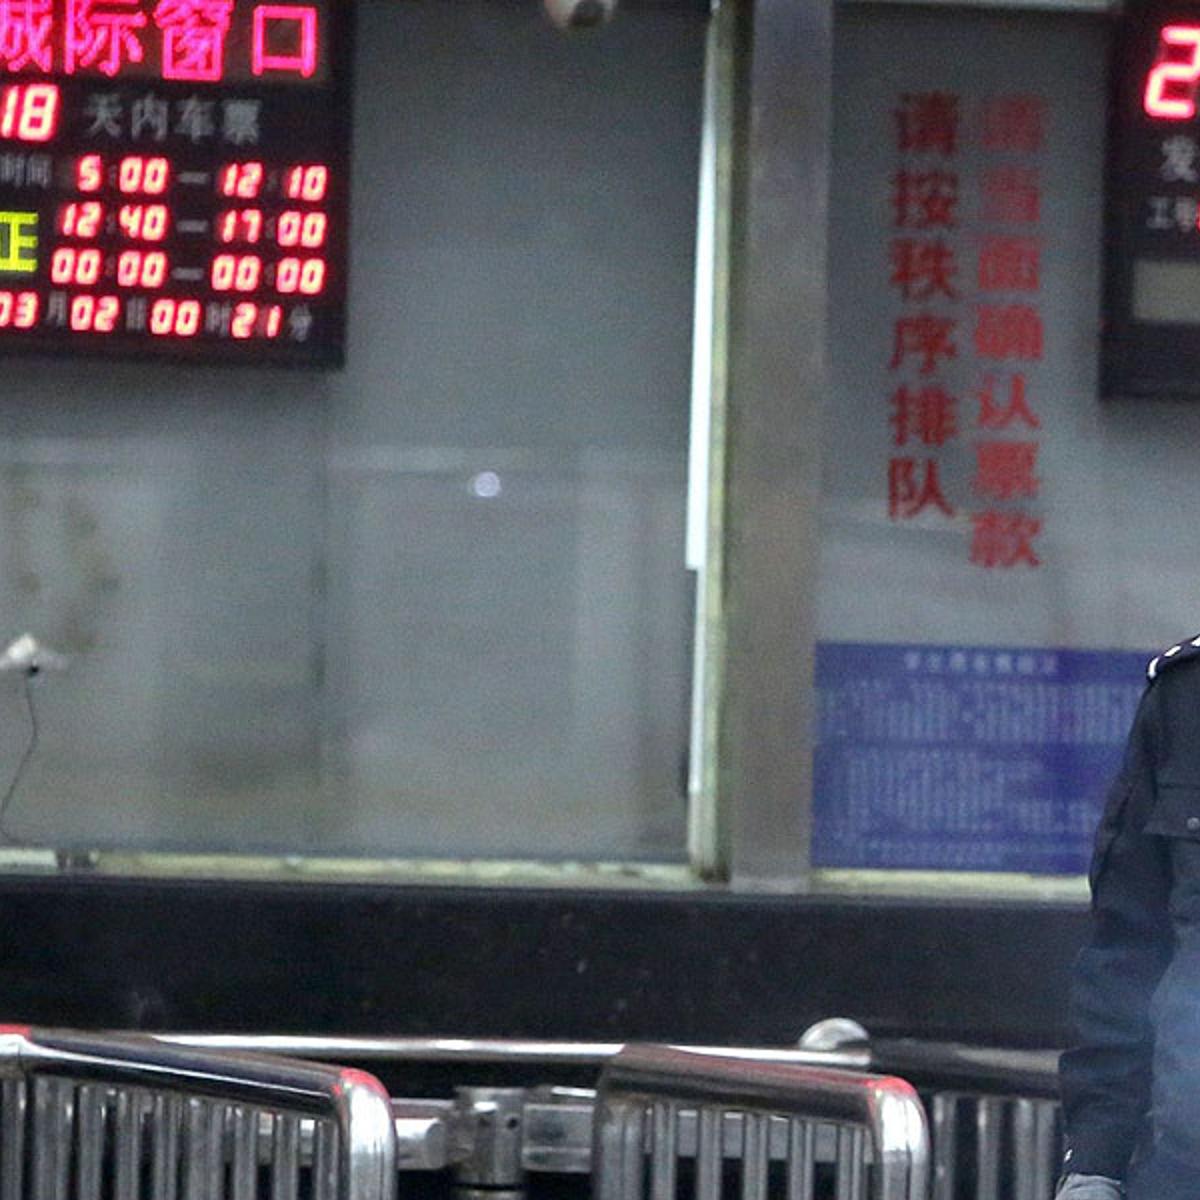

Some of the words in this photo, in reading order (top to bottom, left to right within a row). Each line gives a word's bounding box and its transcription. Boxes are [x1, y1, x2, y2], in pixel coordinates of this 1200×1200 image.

[0, 84, 59, 141] 18
[84, 95, 260, 144] 天内车票
